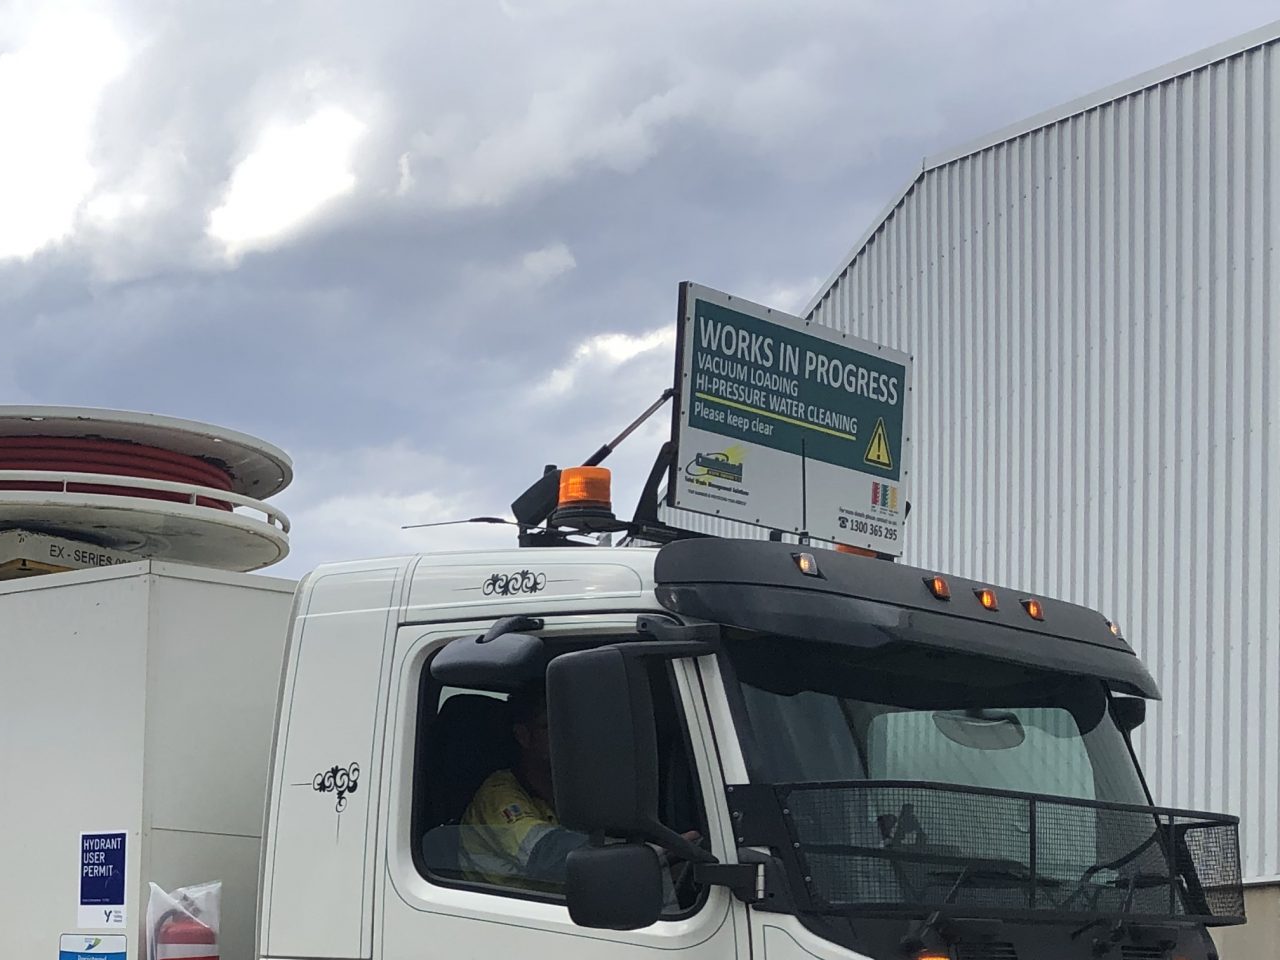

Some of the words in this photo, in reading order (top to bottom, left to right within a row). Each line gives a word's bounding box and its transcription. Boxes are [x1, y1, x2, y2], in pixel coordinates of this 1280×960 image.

[700, 316, 774, 367] WORKS
[779, 342, 800, 376] IN
[805, 350, 898, 405] PROGRESS
[698, 351, 748, 382] VACUUM
[750, 367, 799, 397] LOADING
[696, 373, 767, 408] HI-PRESSURE
[769, 394, 805, 419] WATER
[807, 405, 858, 434] CLEANING
[694, 402, 725, 423] Please
[726, 409, 750, 432] keep
[751, 417, 774, 436] clear
[850, 519, 868, 534] 1300
[869, 523, 883, 538] 365
[884, 527, 898, 541] 295
[50, 544, 65, 559] EX
[73, 550, 113, 567] SERIES
[83, 837, 122, 850] HYDRANT
[83, 852, 105, 864] USER
[83, 865, 114, 877] PERMIT
